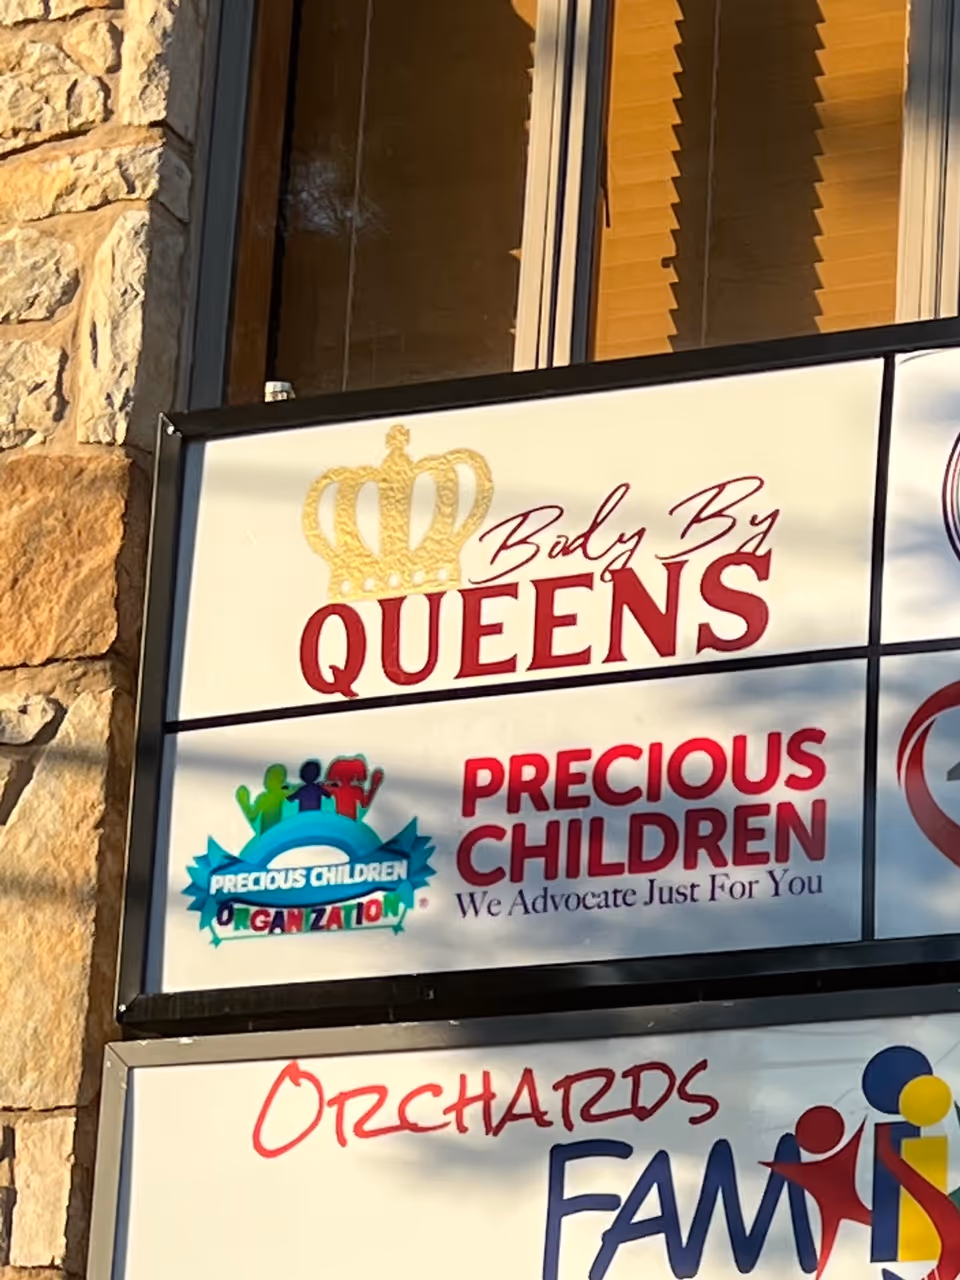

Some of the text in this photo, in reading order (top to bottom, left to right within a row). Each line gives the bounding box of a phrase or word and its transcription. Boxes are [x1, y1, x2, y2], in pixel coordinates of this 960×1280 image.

[467, 475, 780, 584] Body By
[299, 548, 773, 700] QUEENS
[461, 726, 828, 818] PRECIOUS
[209, 860, 408, 895] PRECIOUS CHILDREN
[455, 798, 828, 888] CHILDREN
[215, 891, 401, 936] ORGANIZATION
[455, 868, 824, 919] We Advocate Just For You
